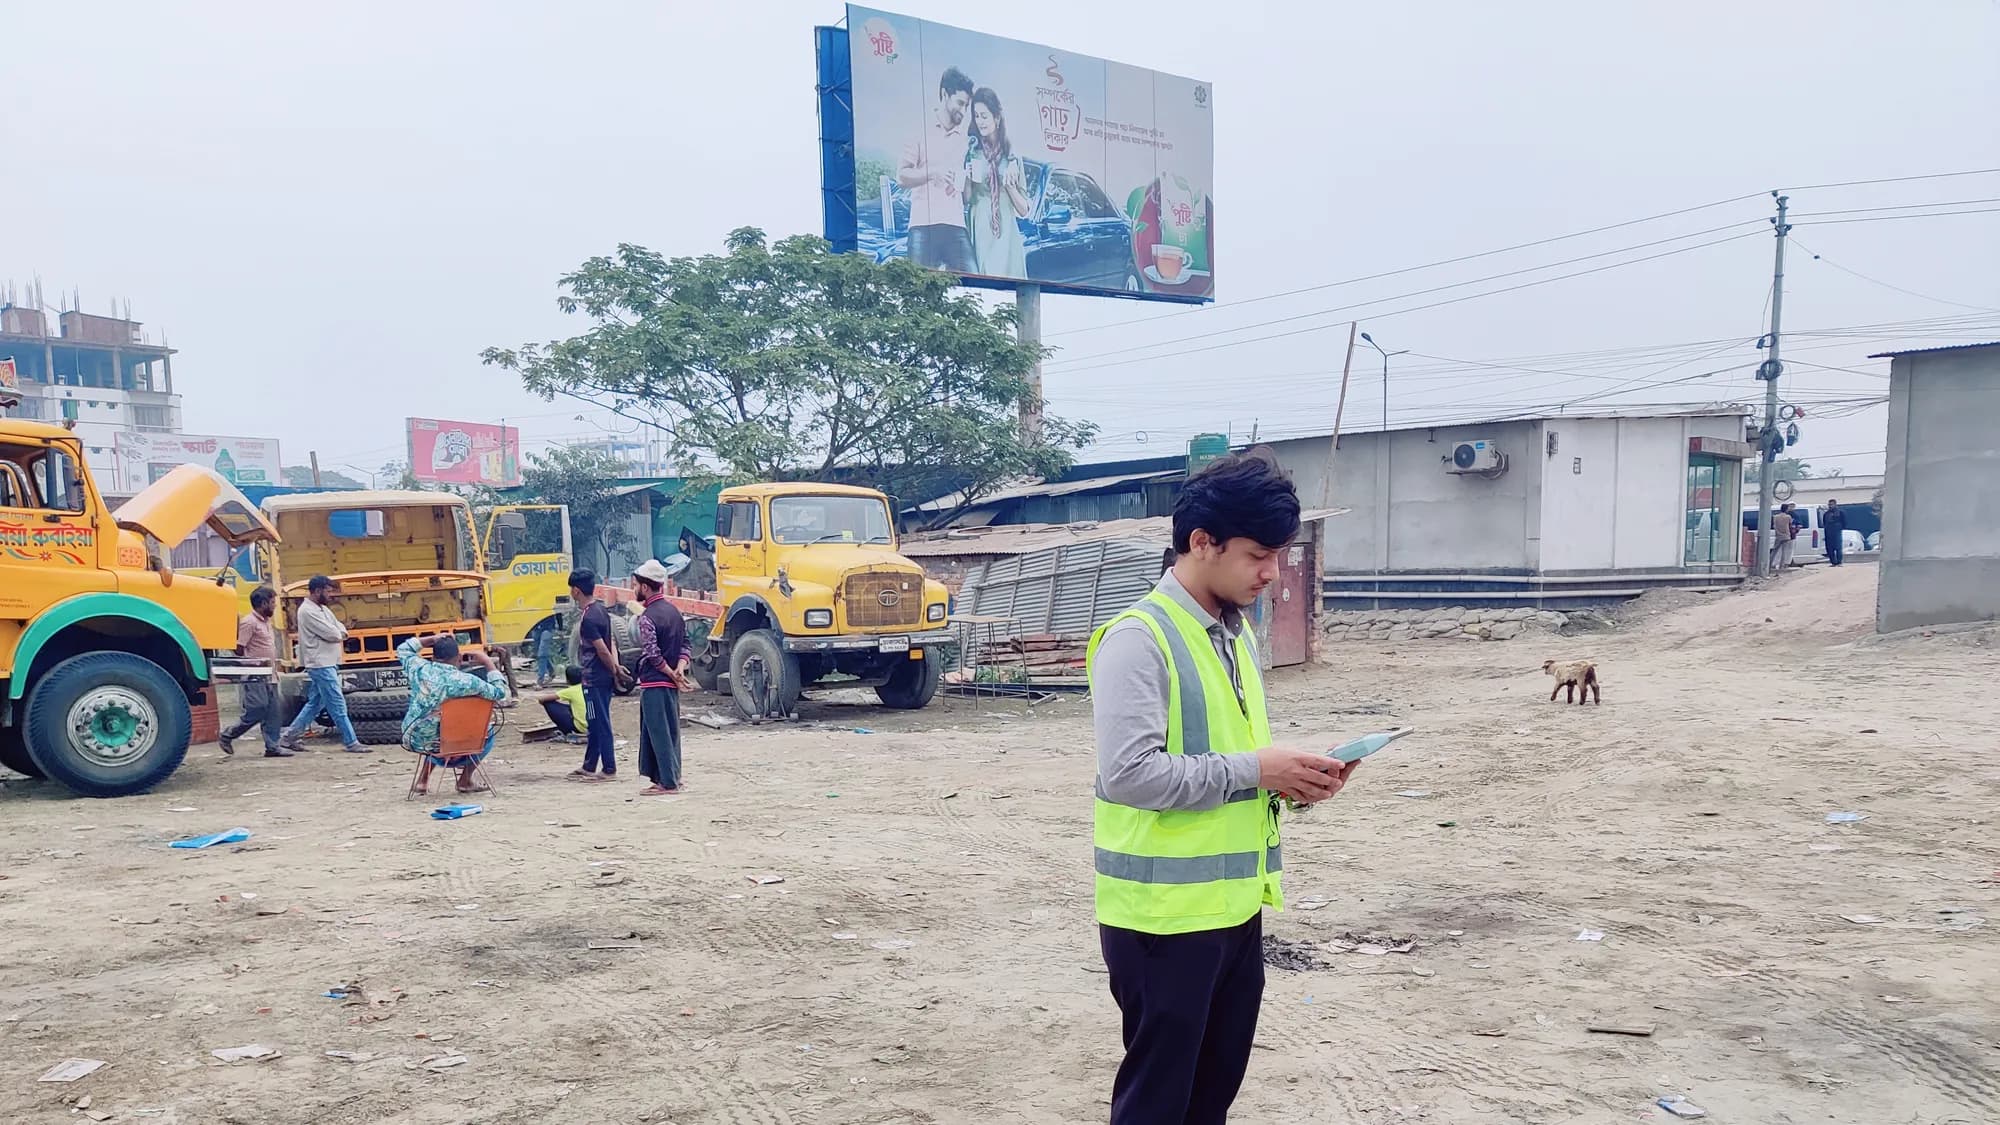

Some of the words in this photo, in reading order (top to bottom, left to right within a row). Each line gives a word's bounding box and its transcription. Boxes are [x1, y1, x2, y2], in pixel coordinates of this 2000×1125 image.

[870, 32, 893, 56] পুষ্টি
[1044, 128, 1069, 145] লিকার
[512, 561, 547, 577] তোয়া
